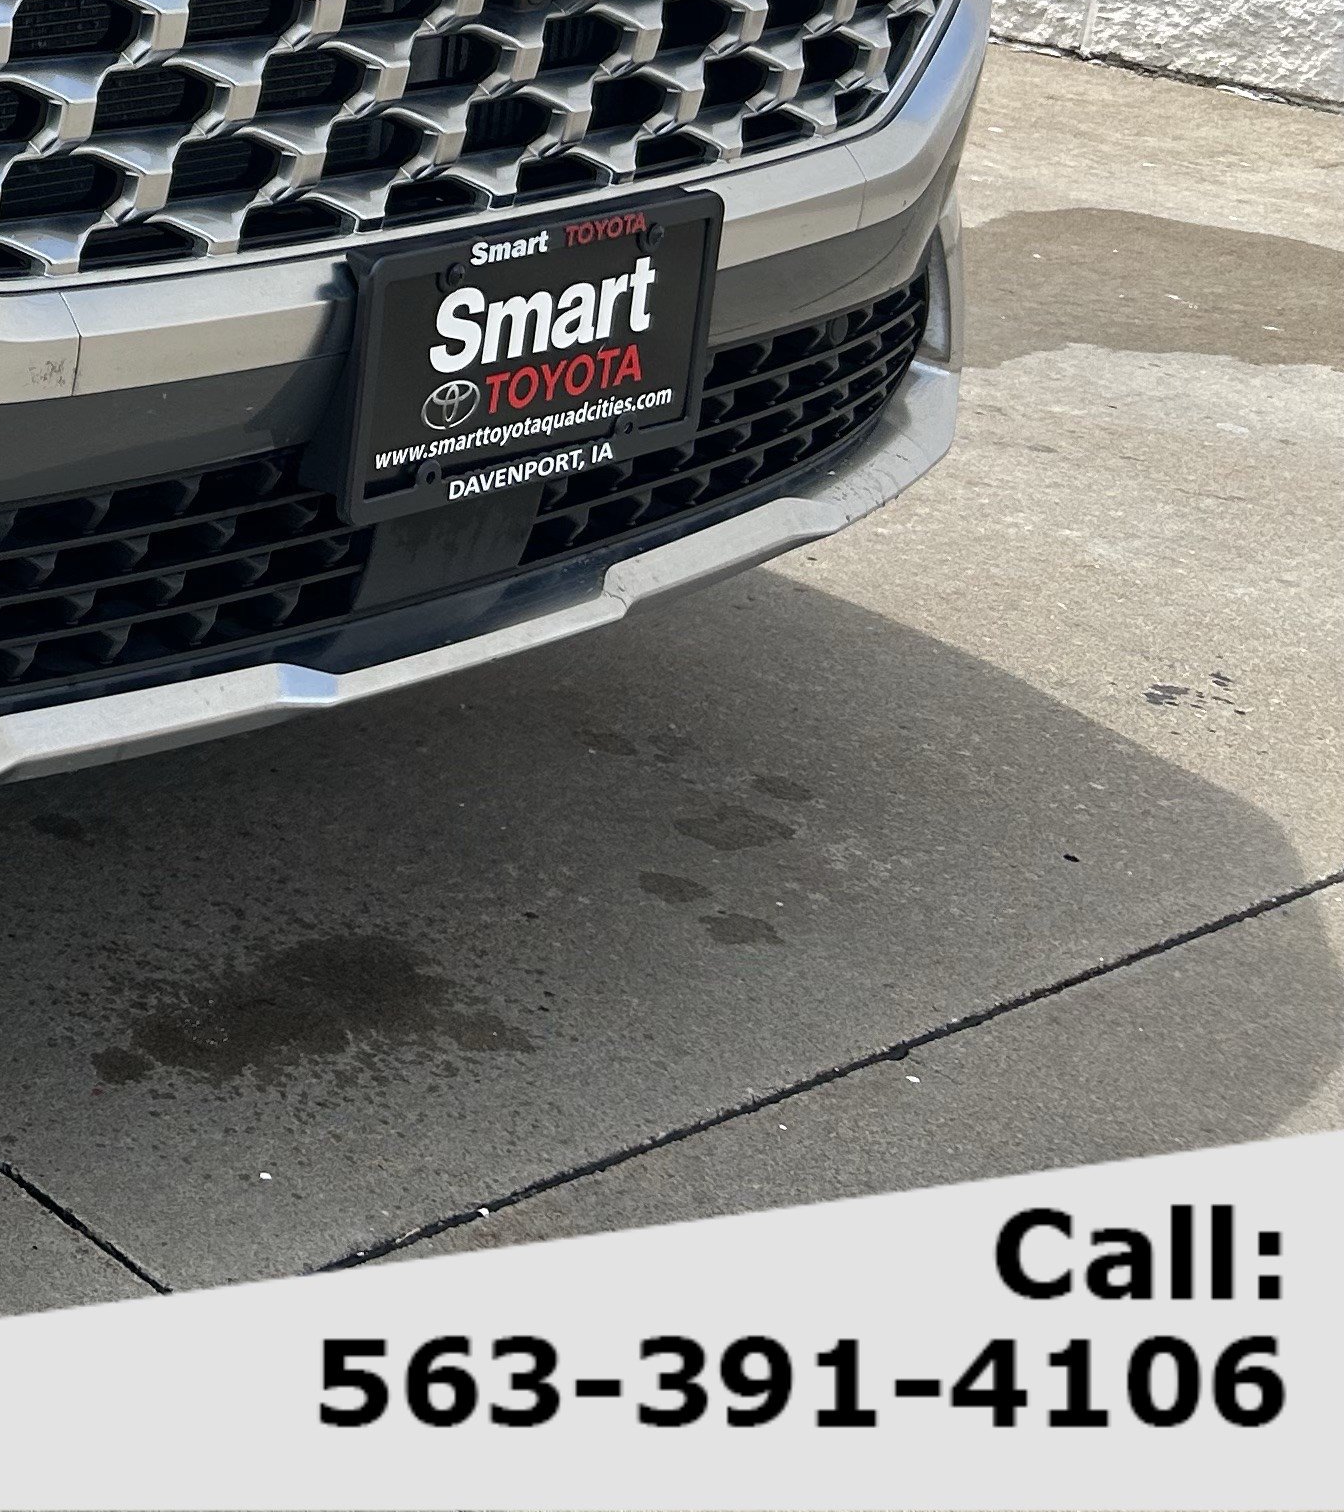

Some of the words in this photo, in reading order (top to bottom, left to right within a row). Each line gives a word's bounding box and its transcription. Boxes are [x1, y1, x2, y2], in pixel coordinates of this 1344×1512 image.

[469, 230, 549, 267] Smart
[564, 211, 647, 248] TOYOTA
[428, 255, 656, 374] Smart
[484, 343, 644, 415] TOYOTA
[374, 386, 673, 470] www.smarttoyotaquadcities.com
[447, 447, 586, 501] DAVENPORT,
[590, 441, 614, 464] IA
